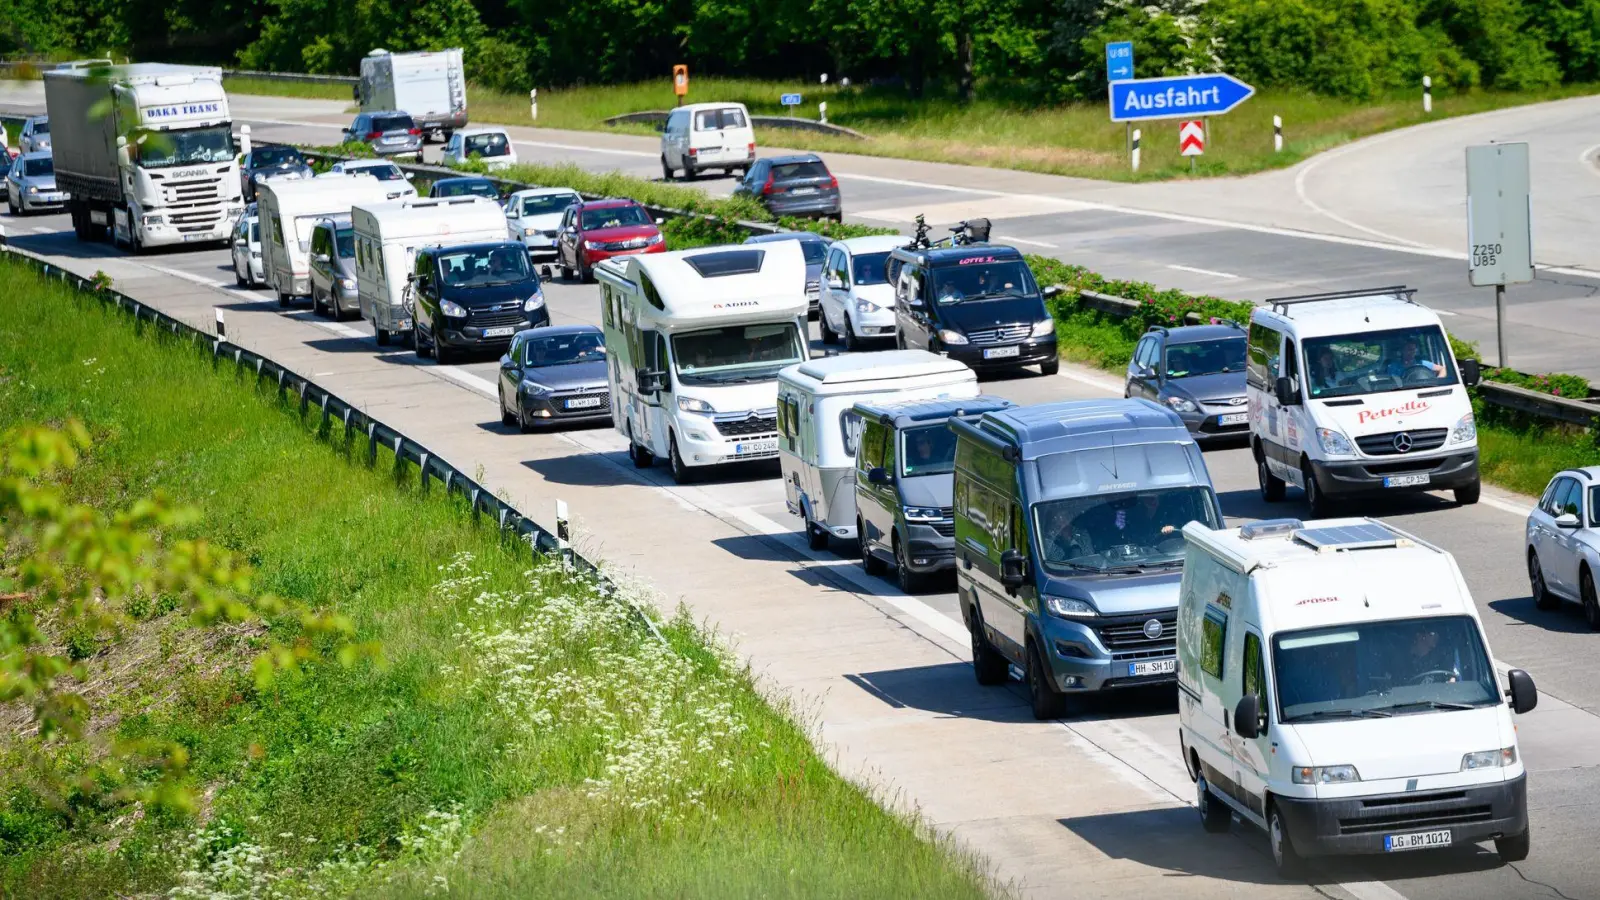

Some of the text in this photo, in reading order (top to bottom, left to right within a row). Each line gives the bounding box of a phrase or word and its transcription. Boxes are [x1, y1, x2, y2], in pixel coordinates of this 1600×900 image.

[1124, 86, 1220, 110] Ausfahrt
[147, 103, 218, 118] DAKA TRANS
[172, 169, 208, 178] SCANIA
[1473, 244, 1502, 255] Z250
[959, 257, 983, 265] LOTTE
[1473, 255, 1496, 266] U85
[1358, 400, 1432, 423] Petrella
[1106, 482, 1137, 490] HYMER
[1135, 661, 1174, 673] HH SH 10
[1391, 832, 1450, 848] LG BM 1012
